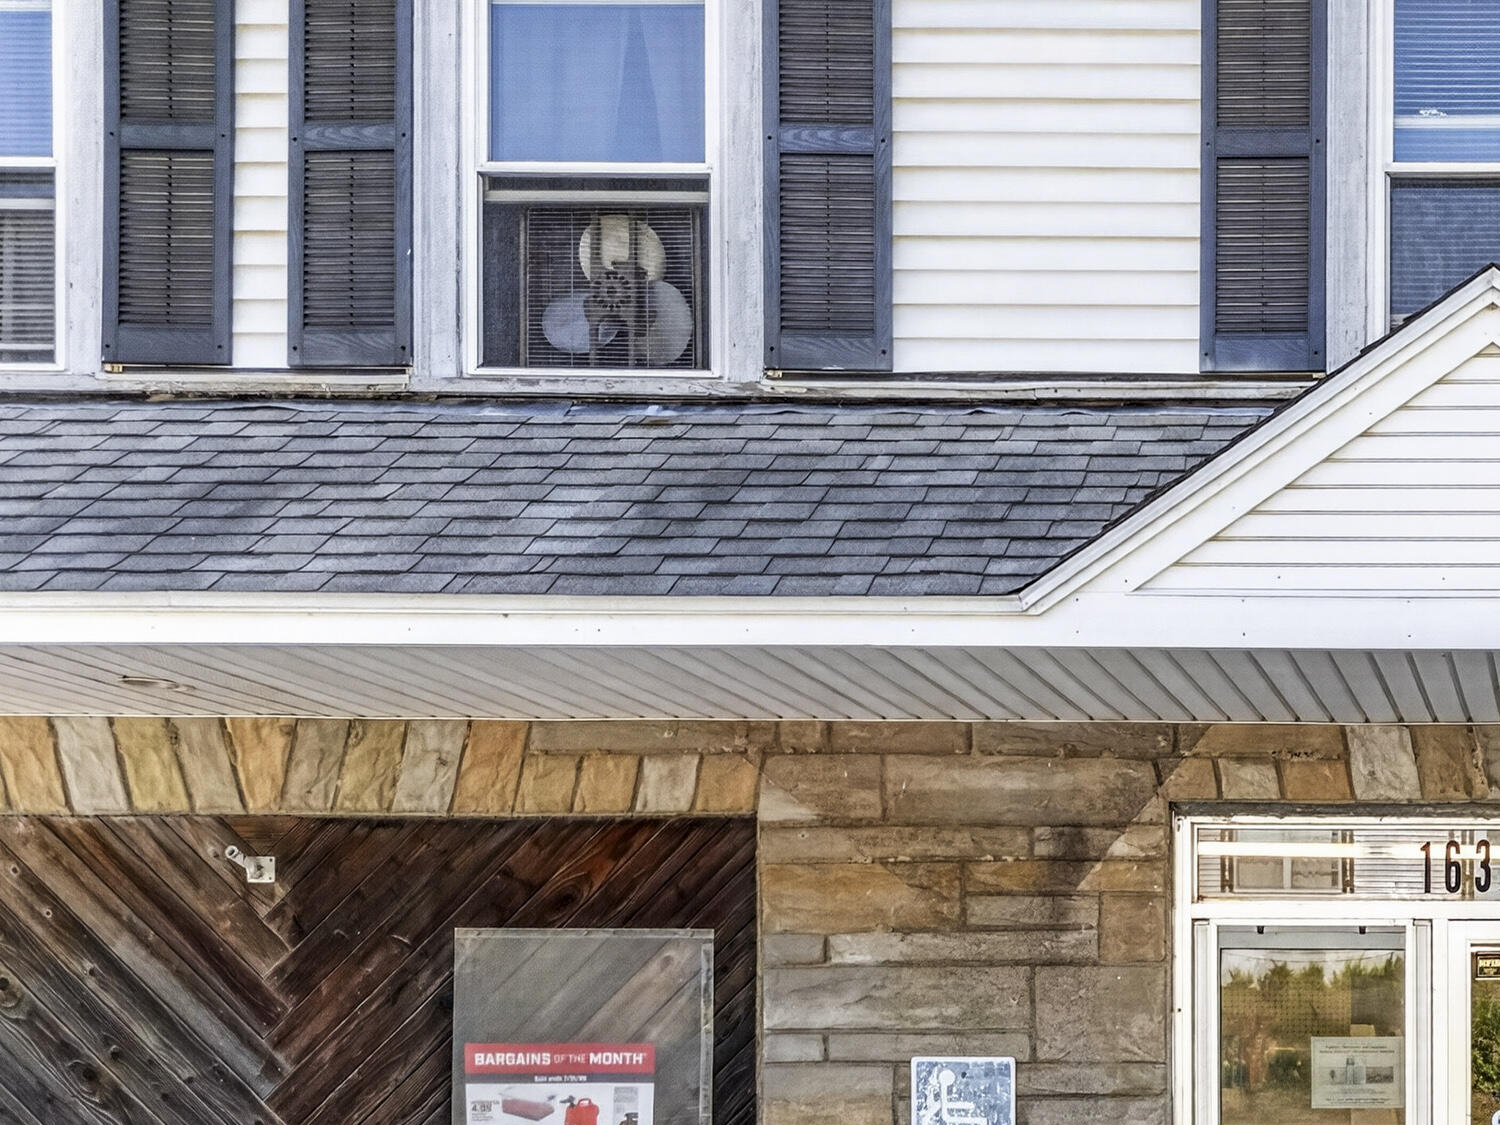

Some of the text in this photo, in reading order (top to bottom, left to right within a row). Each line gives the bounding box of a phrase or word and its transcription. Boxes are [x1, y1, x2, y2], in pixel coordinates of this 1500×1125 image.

[1420, 839, 1491, 893] 163
[474, 1052, 643, 1066] BARGAINS OF THE MONTH
